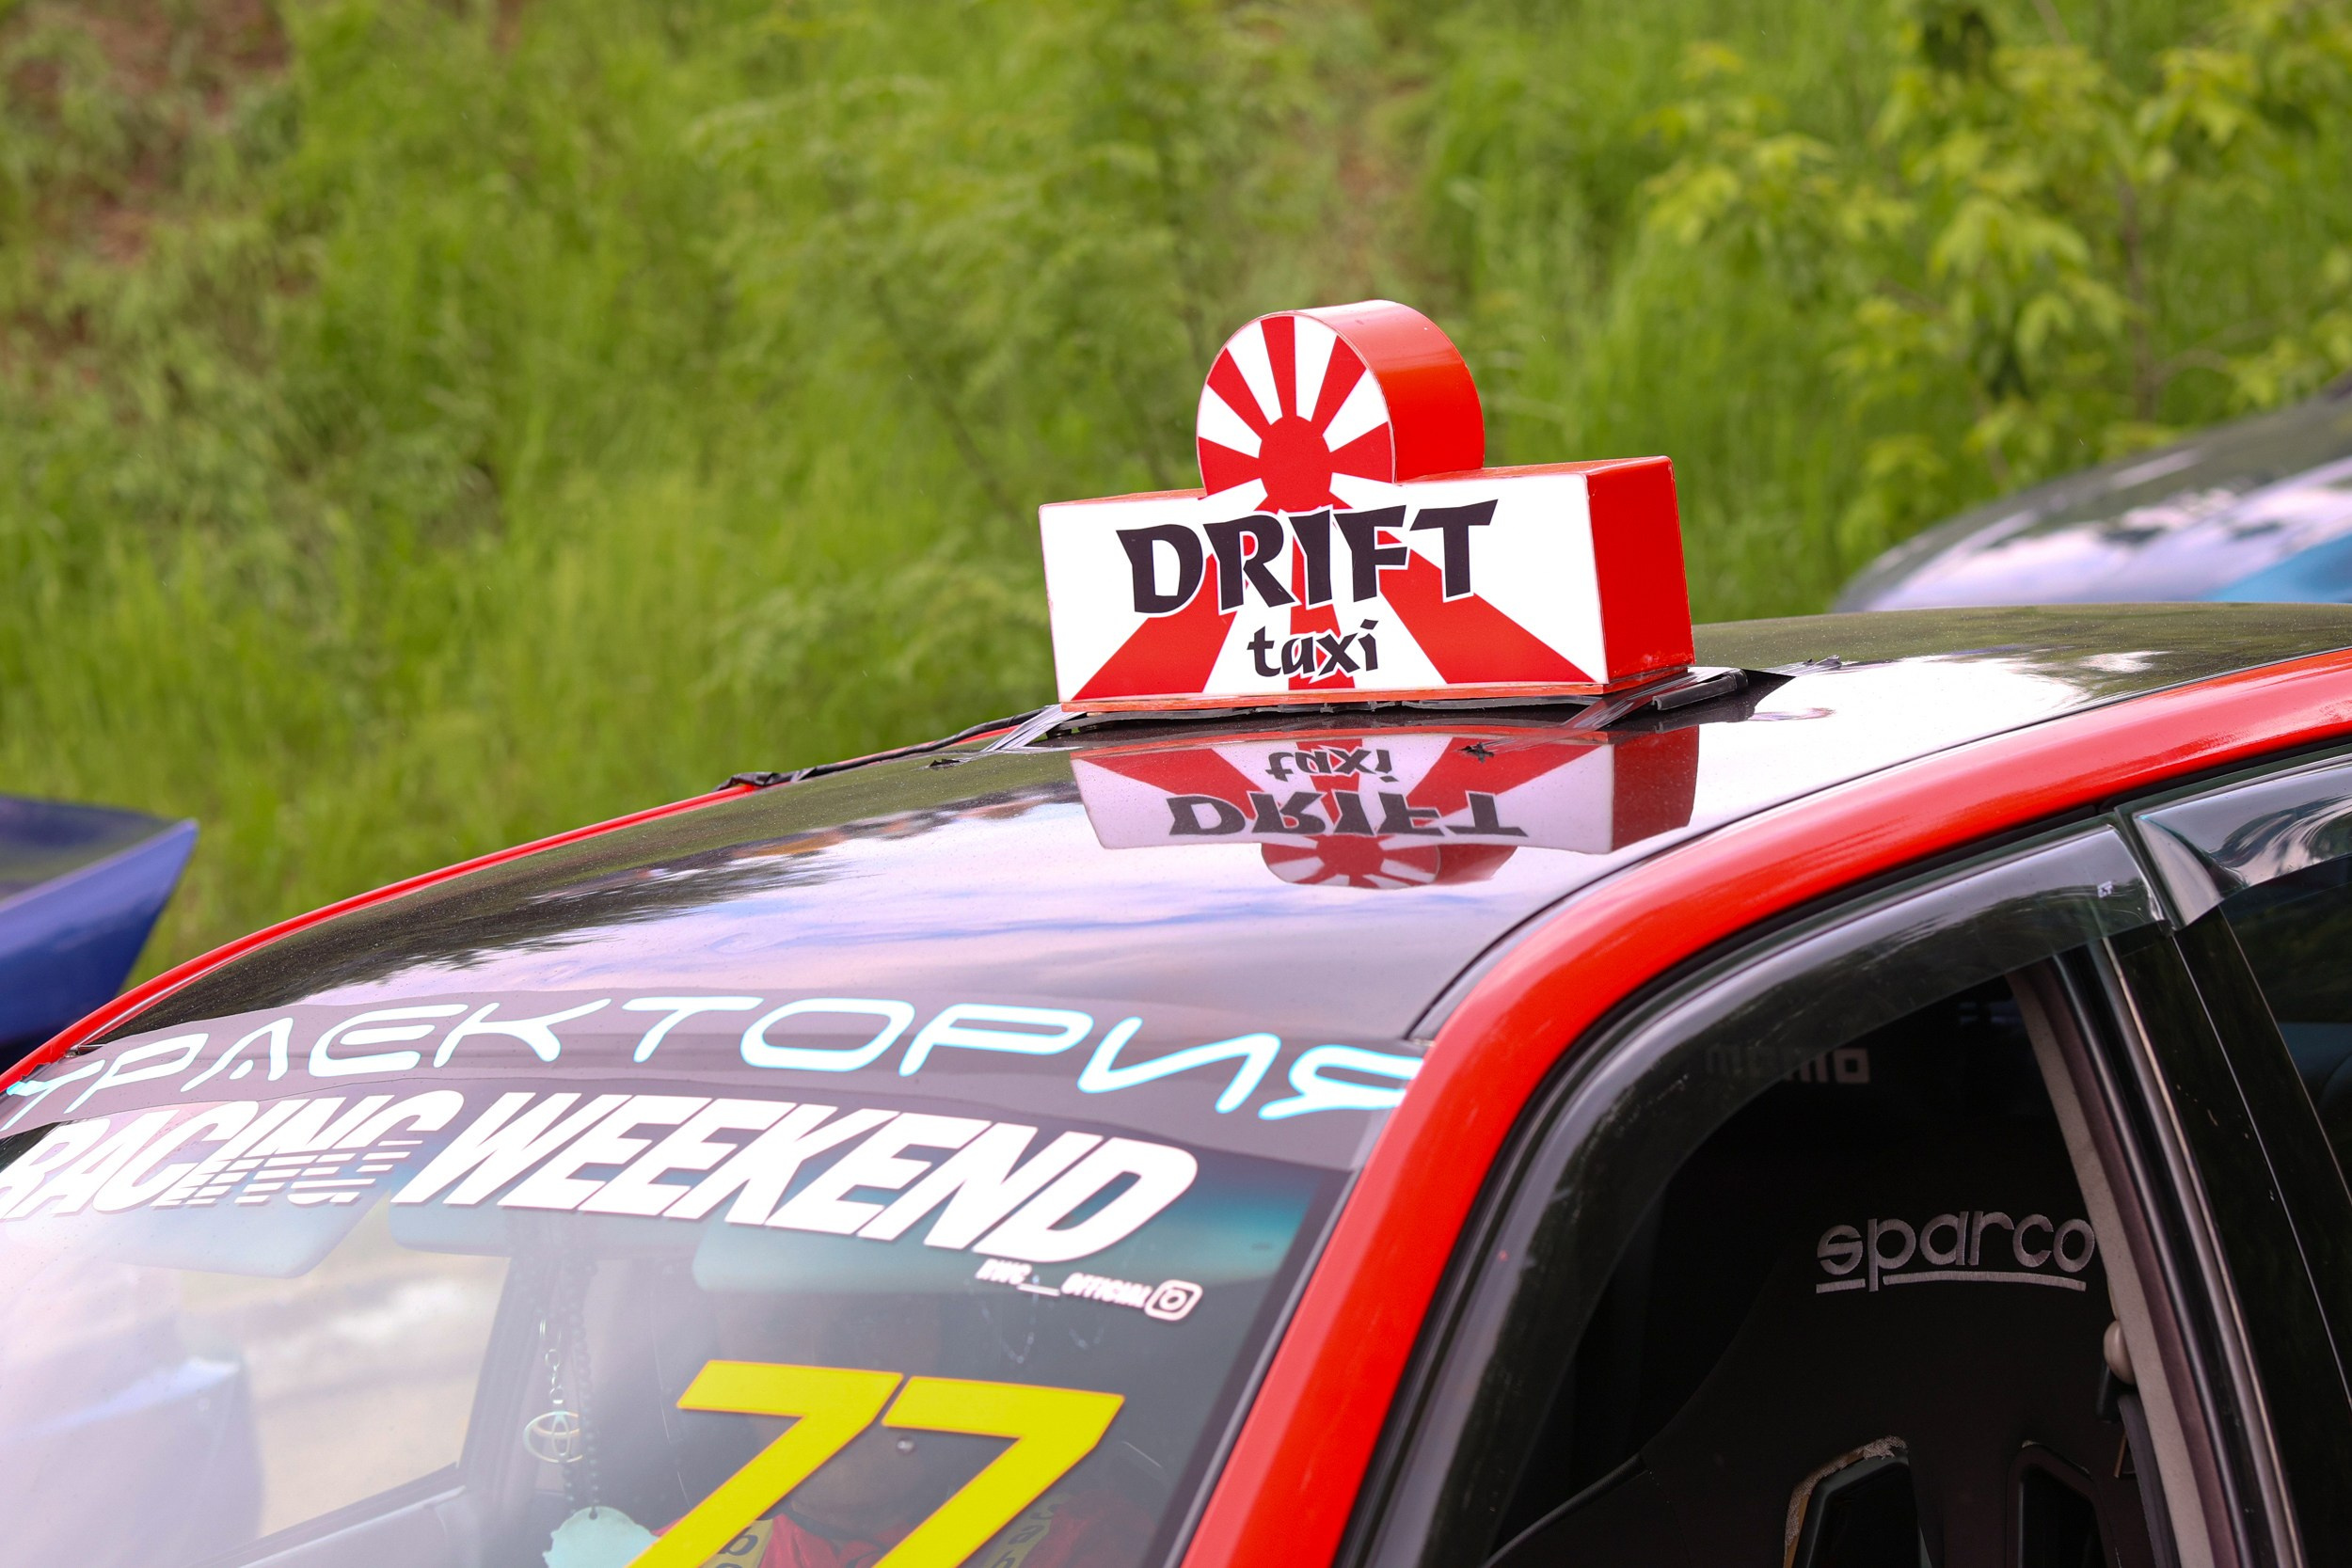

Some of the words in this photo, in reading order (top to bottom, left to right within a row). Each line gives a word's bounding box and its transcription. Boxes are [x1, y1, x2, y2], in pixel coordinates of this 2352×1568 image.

[1115, 499, 1499, 614] DRIFT
[1246, 618, 1379, 678] taxi
[0, 1089, 466, 1219] RACING
[389, 1091, 1199, 1263] WEEKEND
[1816, 1210, 2096, 1292] sparco
[624, 1360, 1125, 1568] 77
